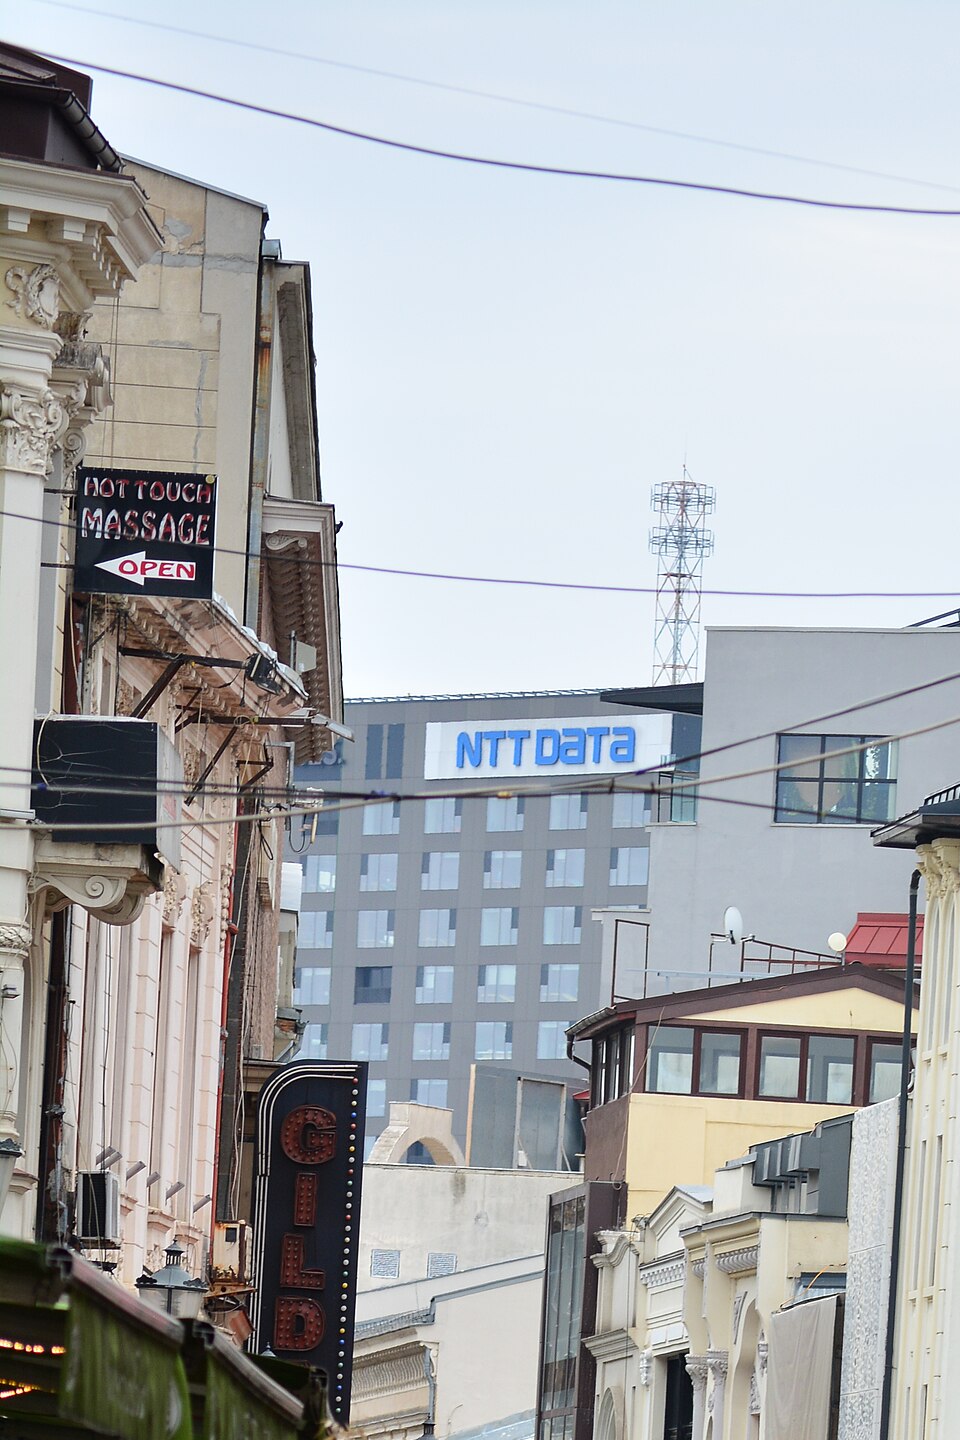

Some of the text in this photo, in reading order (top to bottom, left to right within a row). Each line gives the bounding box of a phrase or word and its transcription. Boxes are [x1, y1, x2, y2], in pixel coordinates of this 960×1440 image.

[84, 476, 212, 504] HOT TOUCH
[81, 507, 211, 545] MASSAGE
[118, 559, 195, 578] OPEN
[456, 729, 530, 768] NTT
